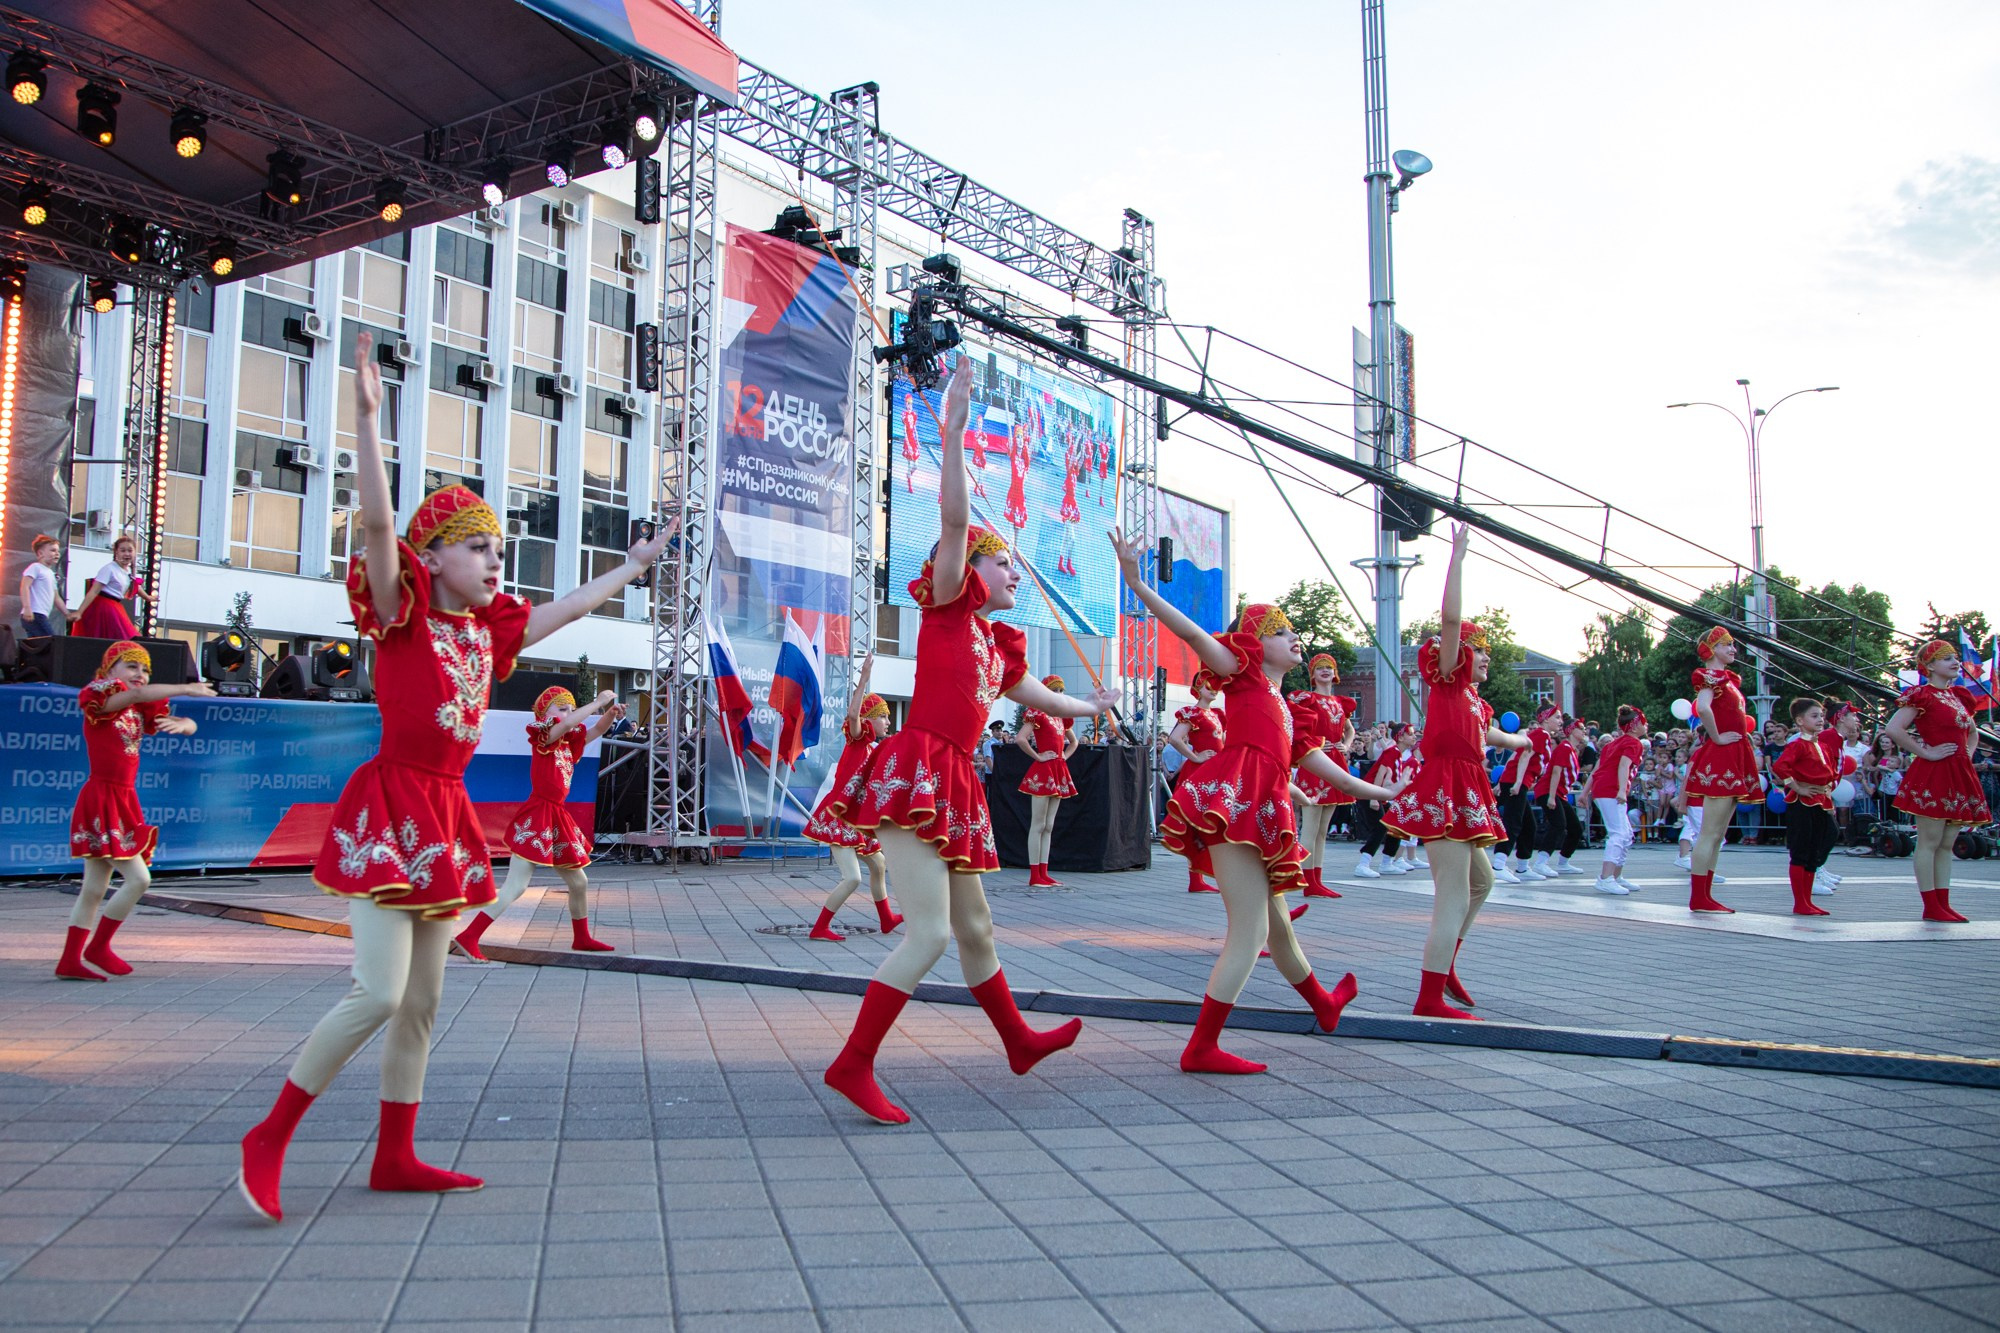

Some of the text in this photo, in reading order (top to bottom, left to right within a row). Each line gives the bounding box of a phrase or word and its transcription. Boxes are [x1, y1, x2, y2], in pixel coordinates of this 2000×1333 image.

[727, 380, 765, 421] 12
[764, 390, 827, 431] ДЕНЬ
[764, 415, 849, 466] РОССИИ
[722, 468, 819, 505] #МыРоссия
[737, 454, 849, 495] #СПраздникомКубань
[139, 736, 256, 757] ЗДРАВЛЯЕМ
